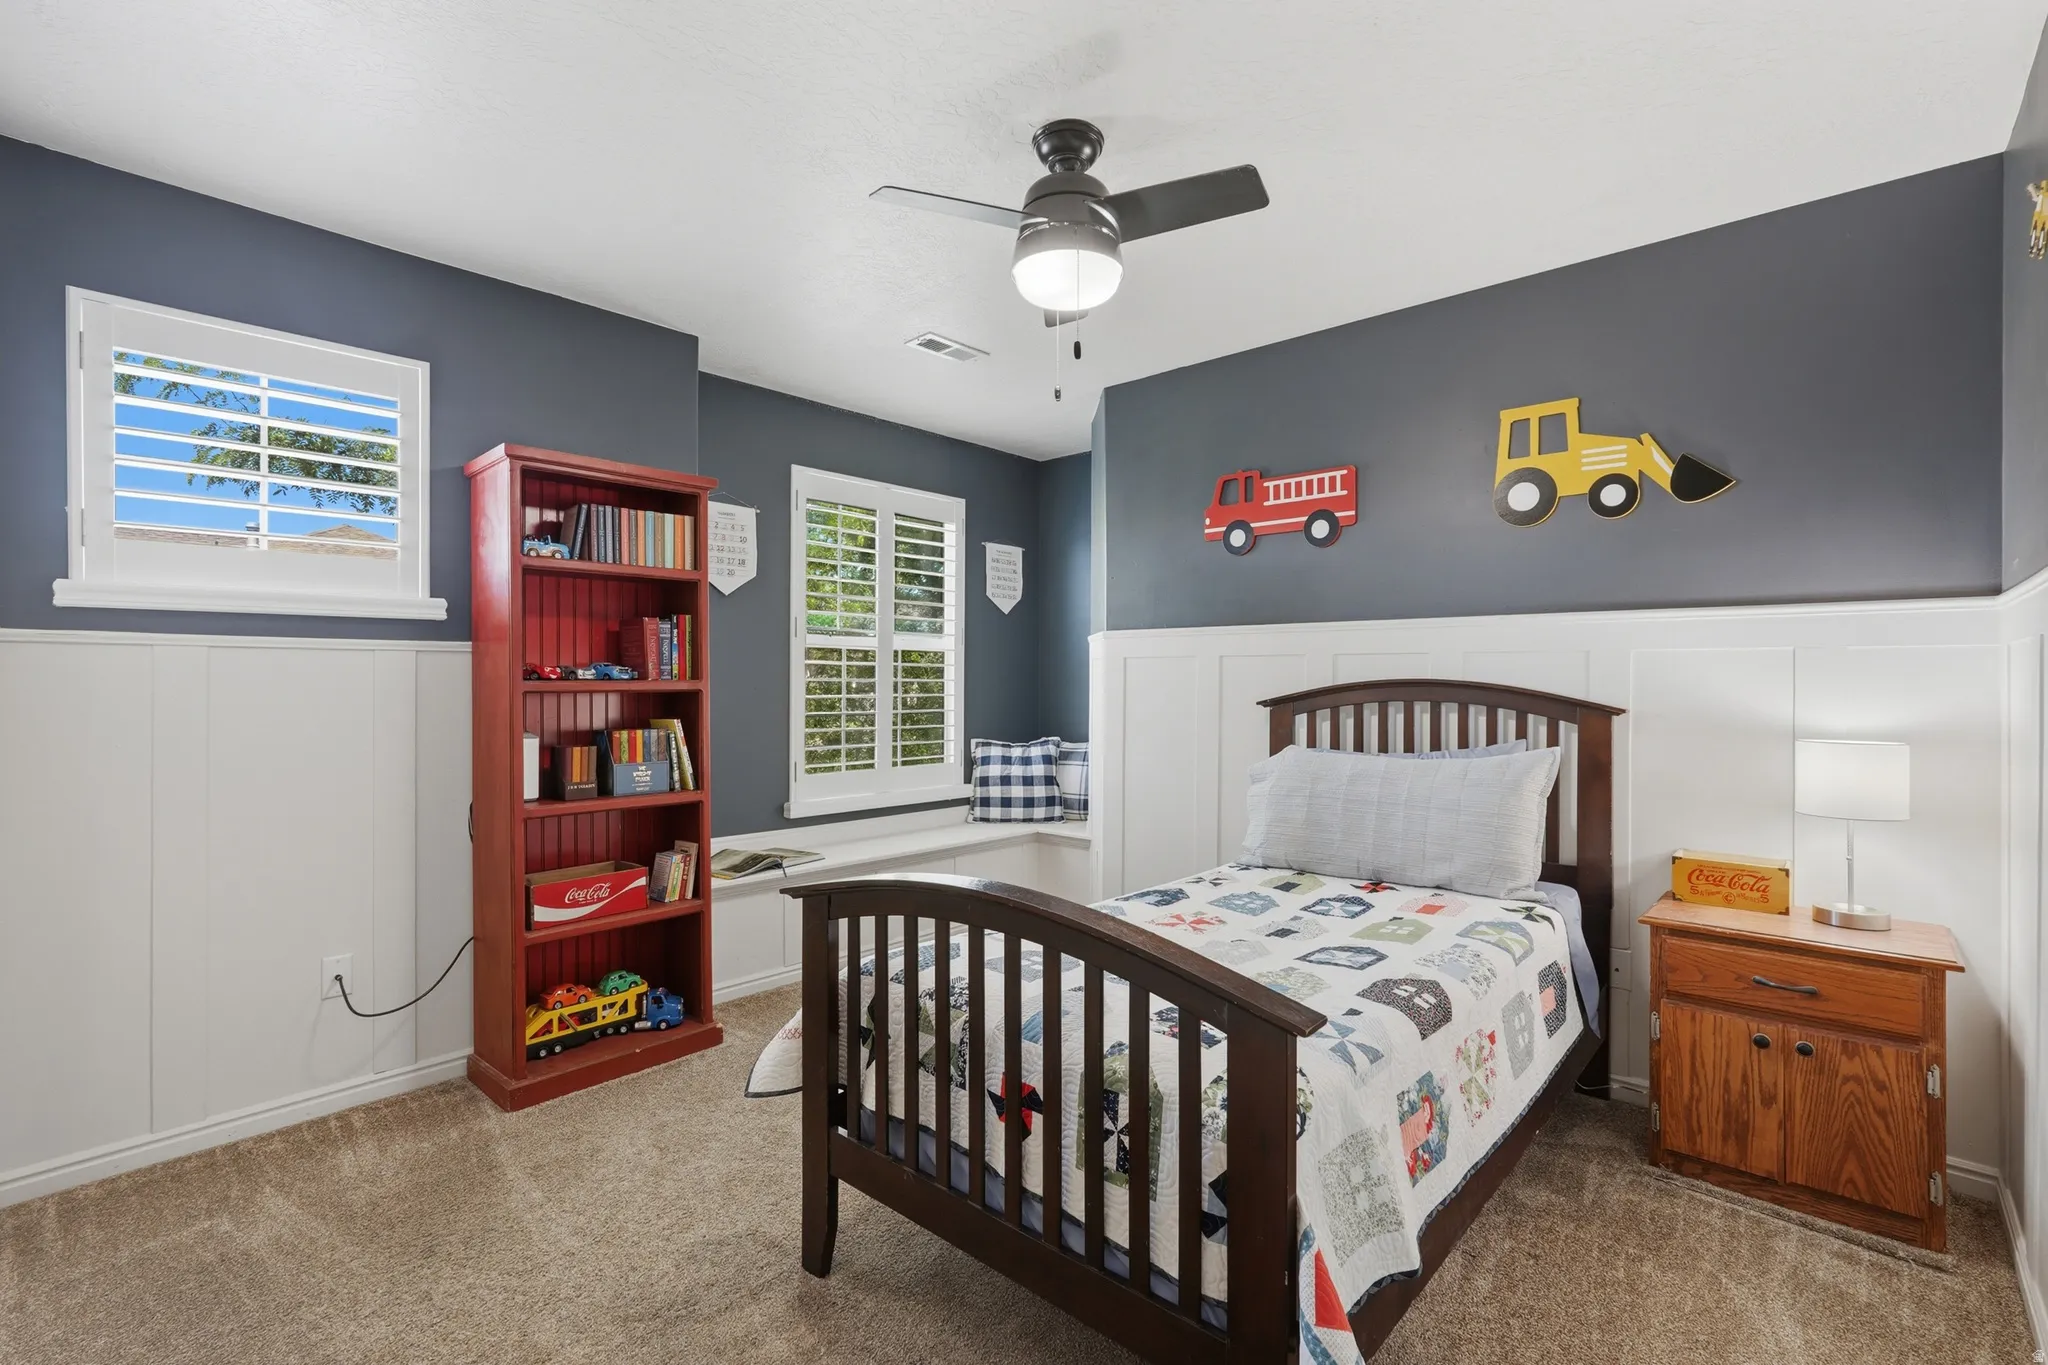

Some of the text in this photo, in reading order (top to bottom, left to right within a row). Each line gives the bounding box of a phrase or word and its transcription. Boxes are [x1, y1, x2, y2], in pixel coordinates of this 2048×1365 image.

[738, 558, 746, 566] 18
[727, 568, 736, 576] 20
[1688, 867, 1772, 894] Coca-Cola
[564, 881, 612, 904] Coca-Cola
